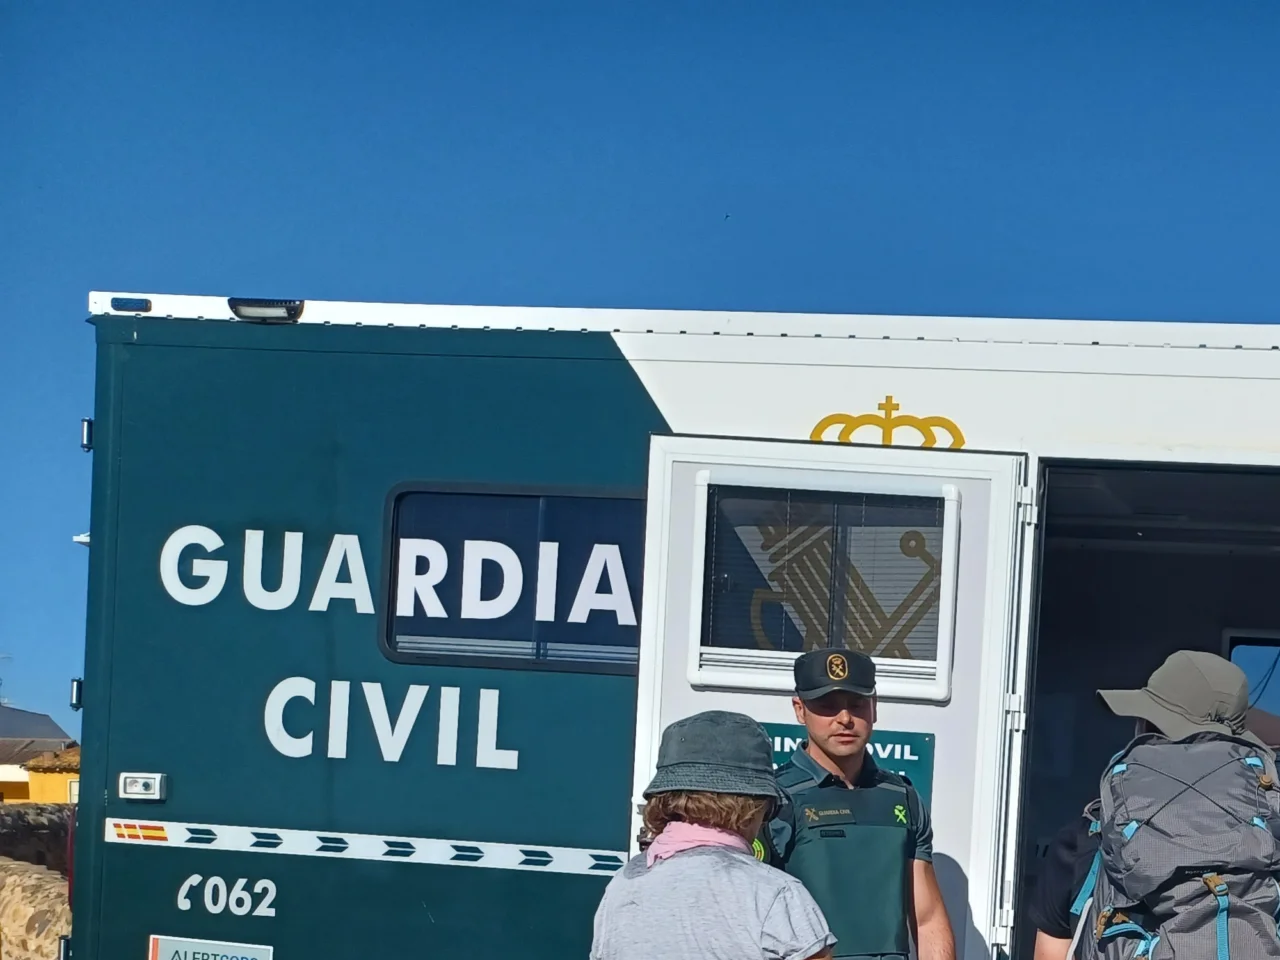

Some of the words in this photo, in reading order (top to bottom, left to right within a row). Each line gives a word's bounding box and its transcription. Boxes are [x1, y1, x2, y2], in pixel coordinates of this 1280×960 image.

[159, 524, 638, 626] GUARDIA
[264, 676, 519, 770] CIVIL
[866, 742, 919, 761] VIL
[203, 875, 277, 917] 062
